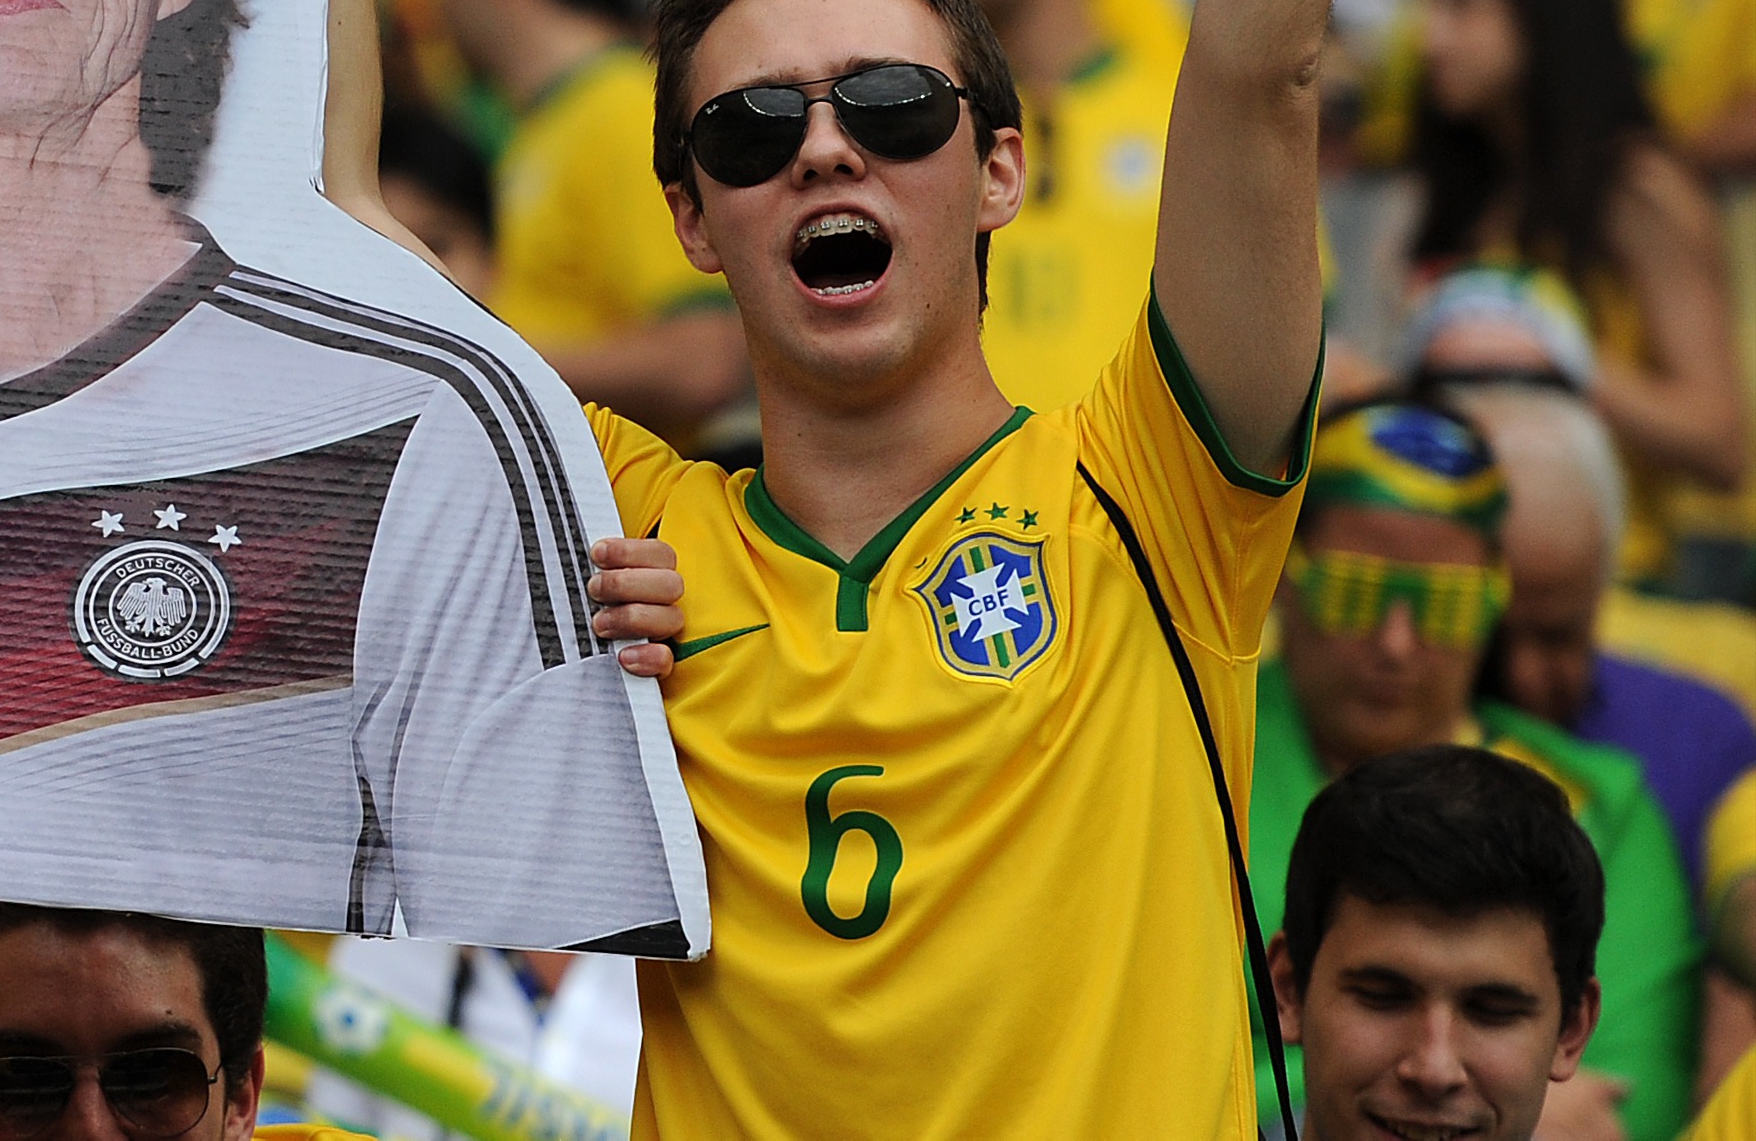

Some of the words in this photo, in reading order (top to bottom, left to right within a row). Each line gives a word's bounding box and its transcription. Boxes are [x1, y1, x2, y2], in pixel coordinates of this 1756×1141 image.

[114, 557, 201, 588] DEUTSCHER
[967, 588, 1010, 617] CBF
[96, 616, 199, 660] FUSSBALL-BUND
[800, 764, 904, 940] 6
